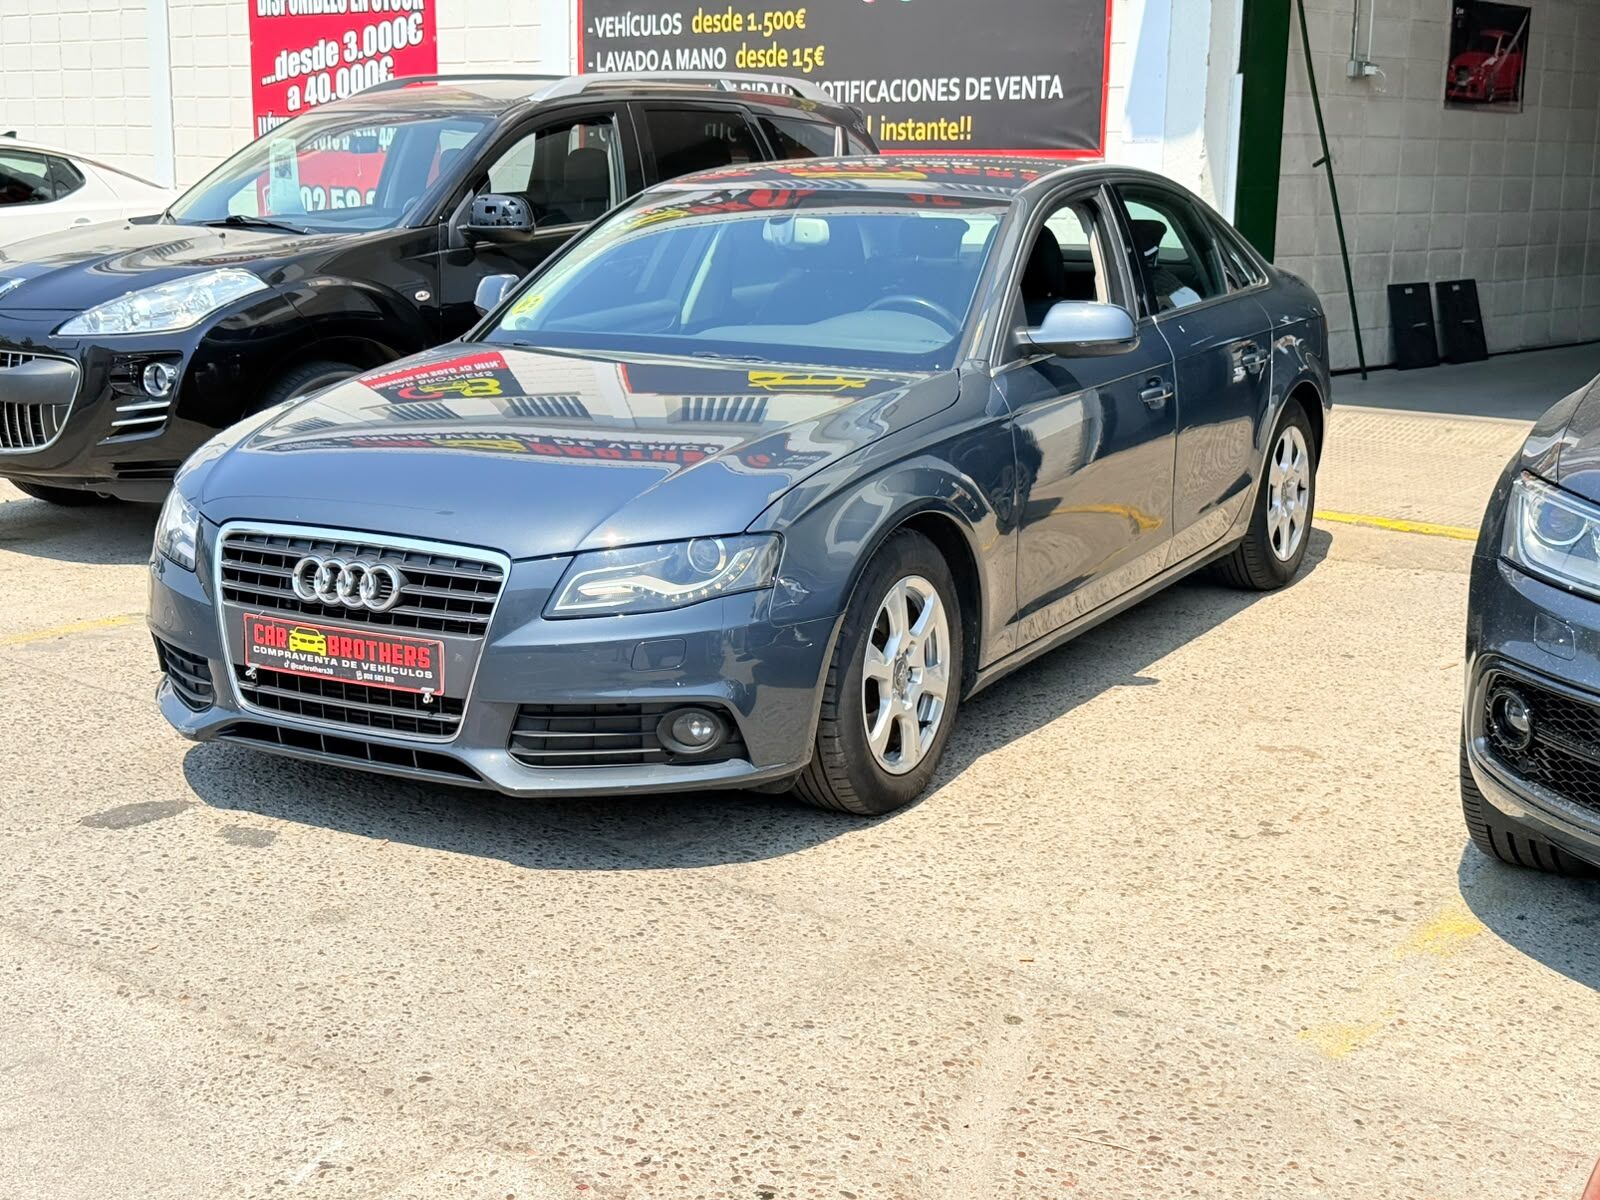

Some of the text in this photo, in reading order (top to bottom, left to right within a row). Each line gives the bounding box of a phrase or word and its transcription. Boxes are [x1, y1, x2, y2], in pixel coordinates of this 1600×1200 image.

[343, 11, 424, 63] 3.000€
[691, 5, 743, 33] desde
[747, 8, 806, 37] 1.500€
[596, 49, 659, 73] LAVADO
[661, 49, 673, 70] A
[676, 47, 727, 71] MANO
[735, 41, 788, 68] desde
[792, 45, 825, 73] 15€
[287, 85, 301, 111] a
[816, 77, 960, 103] OTIFICACIONES
[965, 76, 992, 100] DE
[994, 74, 1064, 99] VENTA
[880, 114, 973, 141] instante!!
[253, 622, 431, 669] CAR BROTHERS
[253, 645, 339, 666] COMPRAVENTA
[342, 659, 358, 669] DE
[361, 660, 433, 679] VEHÍCULOS
